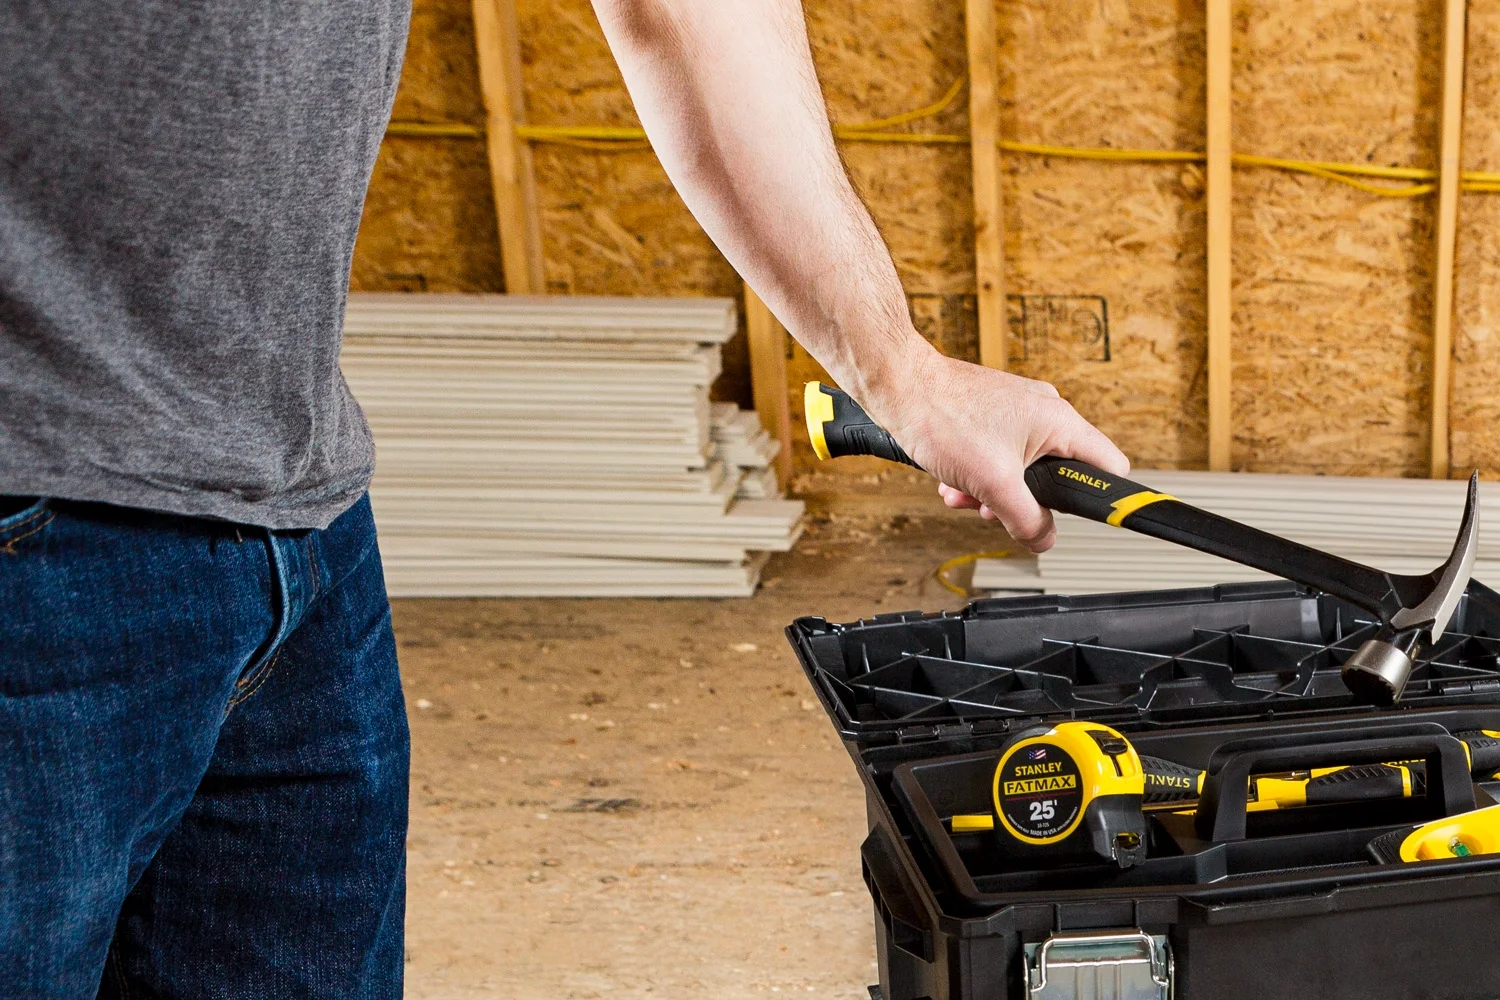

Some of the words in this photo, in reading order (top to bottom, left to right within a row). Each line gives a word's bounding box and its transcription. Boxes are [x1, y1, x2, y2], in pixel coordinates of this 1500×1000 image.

[1057, 466, 1111, 491] STANLEY
[1014, 762, 1062, 777] STANLEY
[1006, 777, 1072, 794] FATMAX
